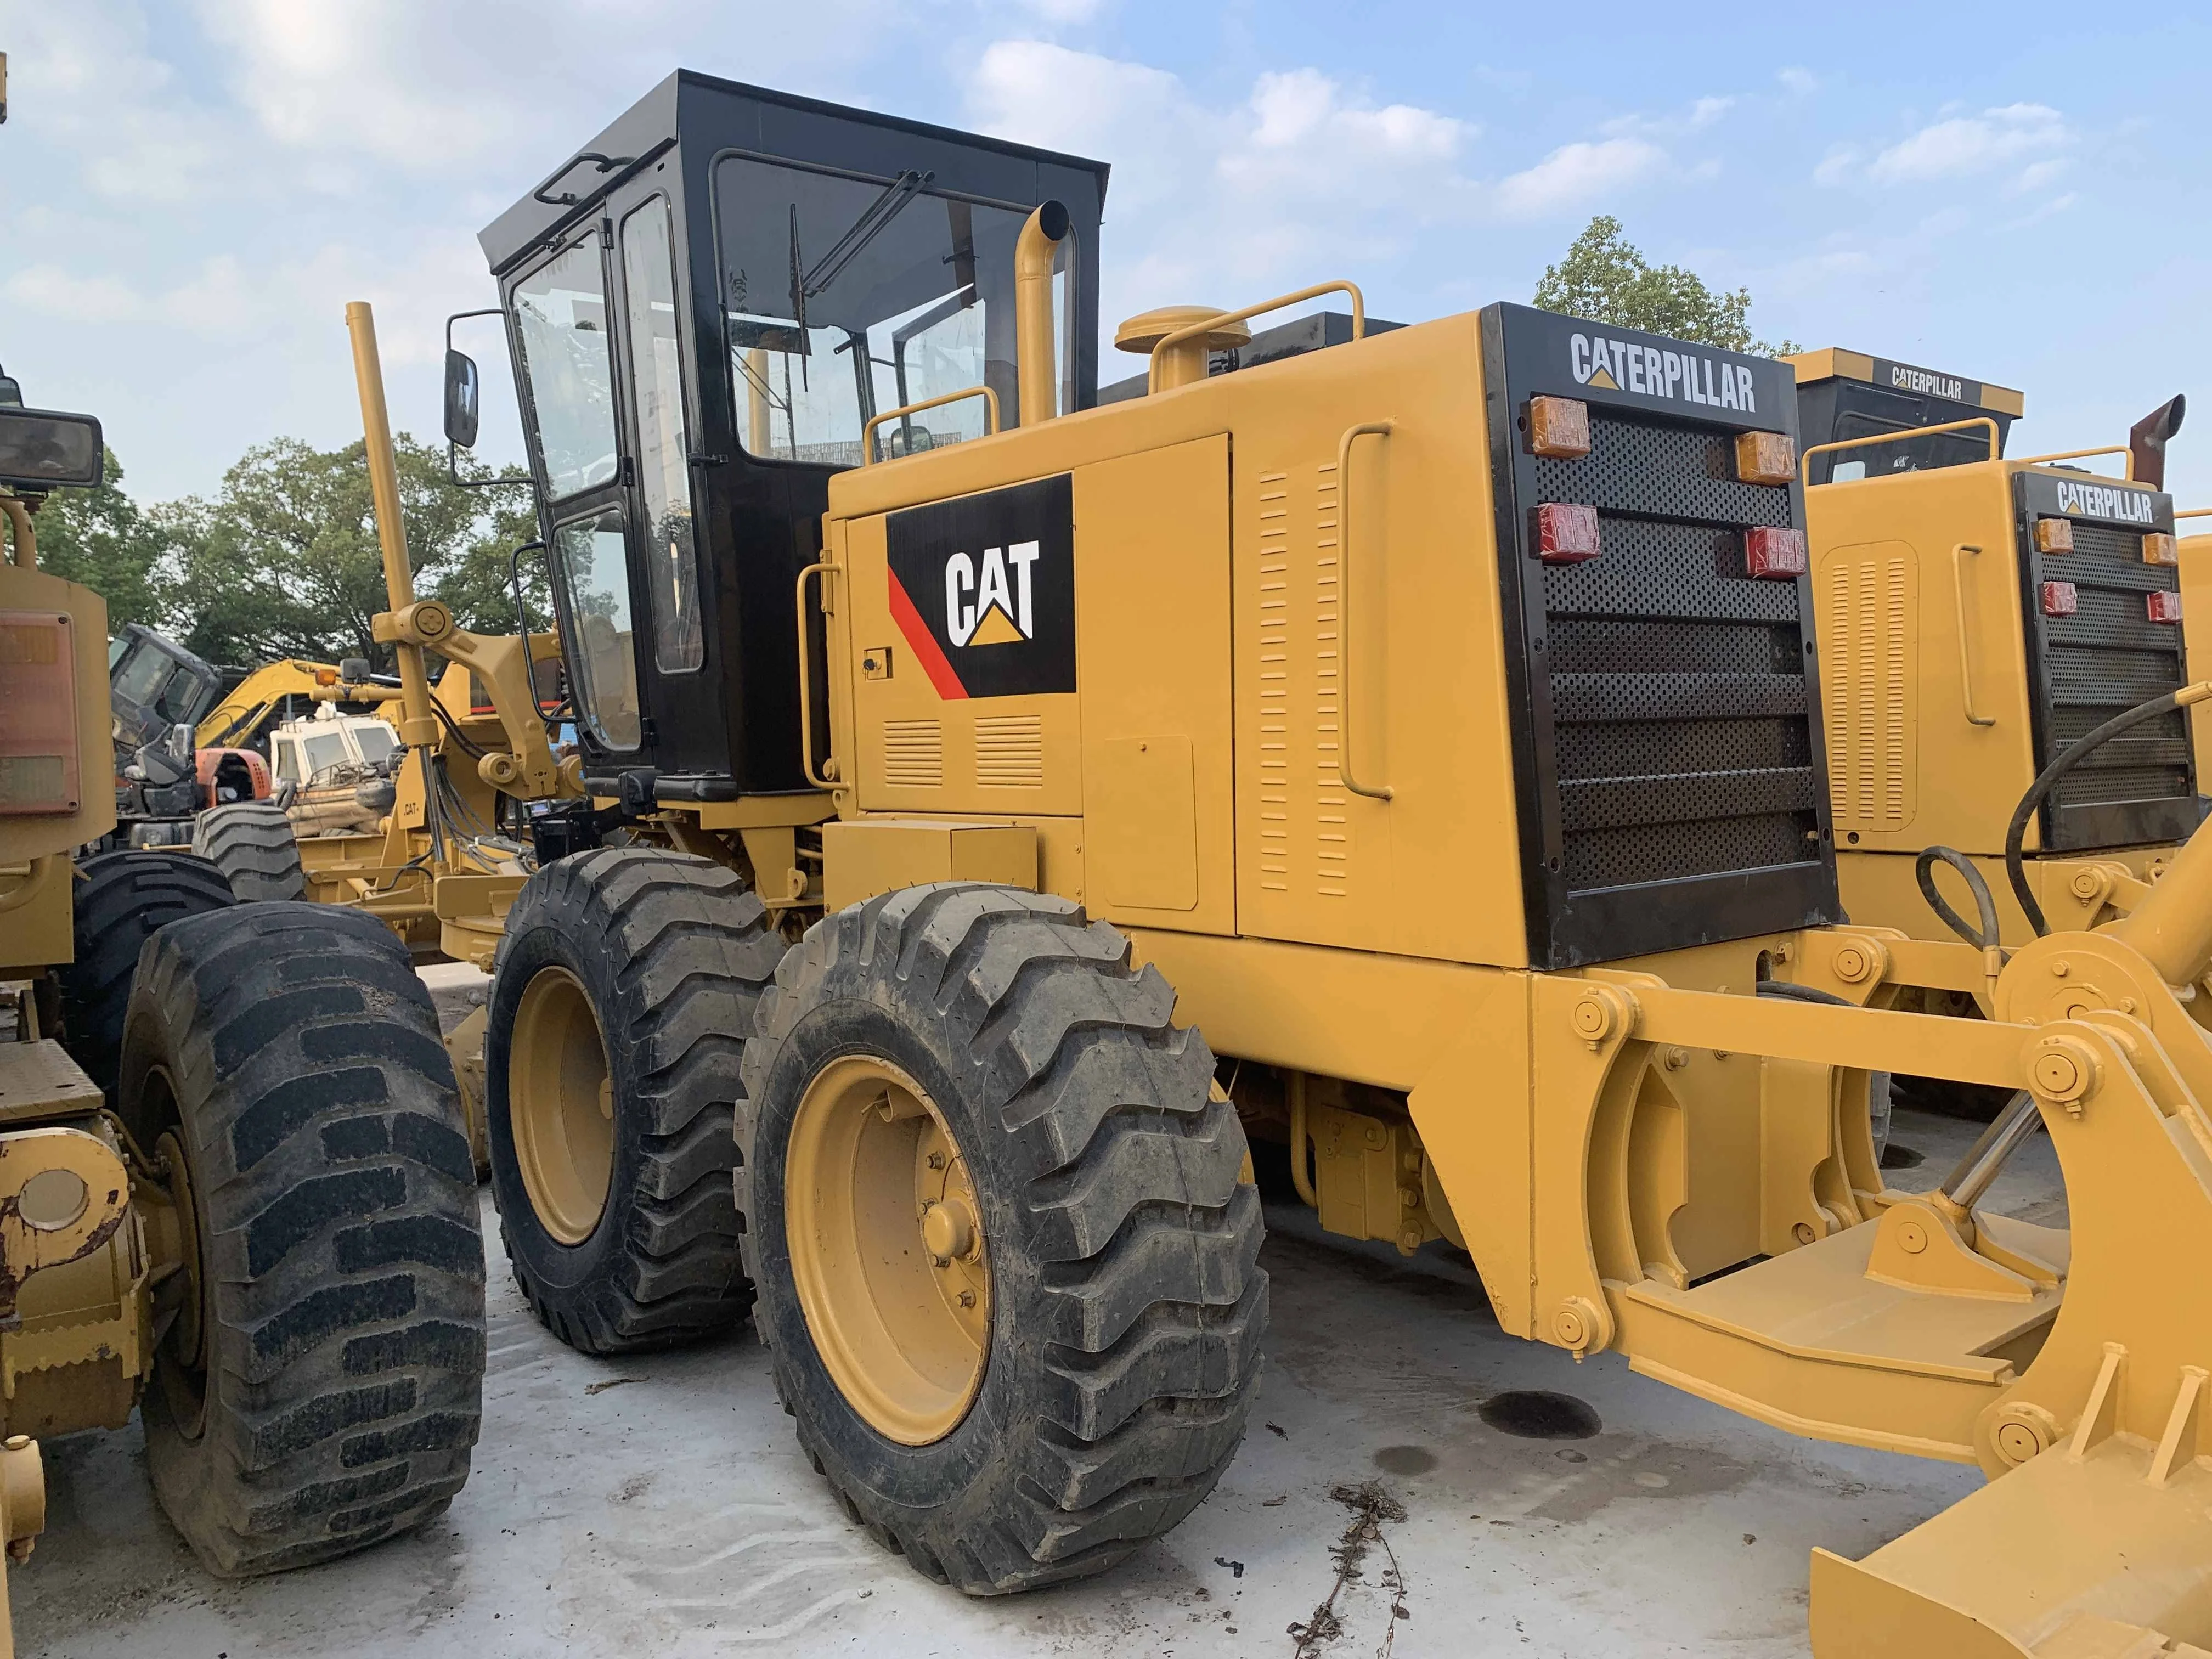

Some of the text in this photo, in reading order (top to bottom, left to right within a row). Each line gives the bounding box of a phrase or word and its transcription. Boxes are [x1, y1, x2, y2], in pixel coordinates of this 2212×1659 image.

[1571, 333, 1756, 413] CATERPILLAR
[1892, 366, 1962, 400] CATERPILLAR
[2057, 481, 2153, 523] CATERPILLAR
[946, 540, 1039, 647] CAT
